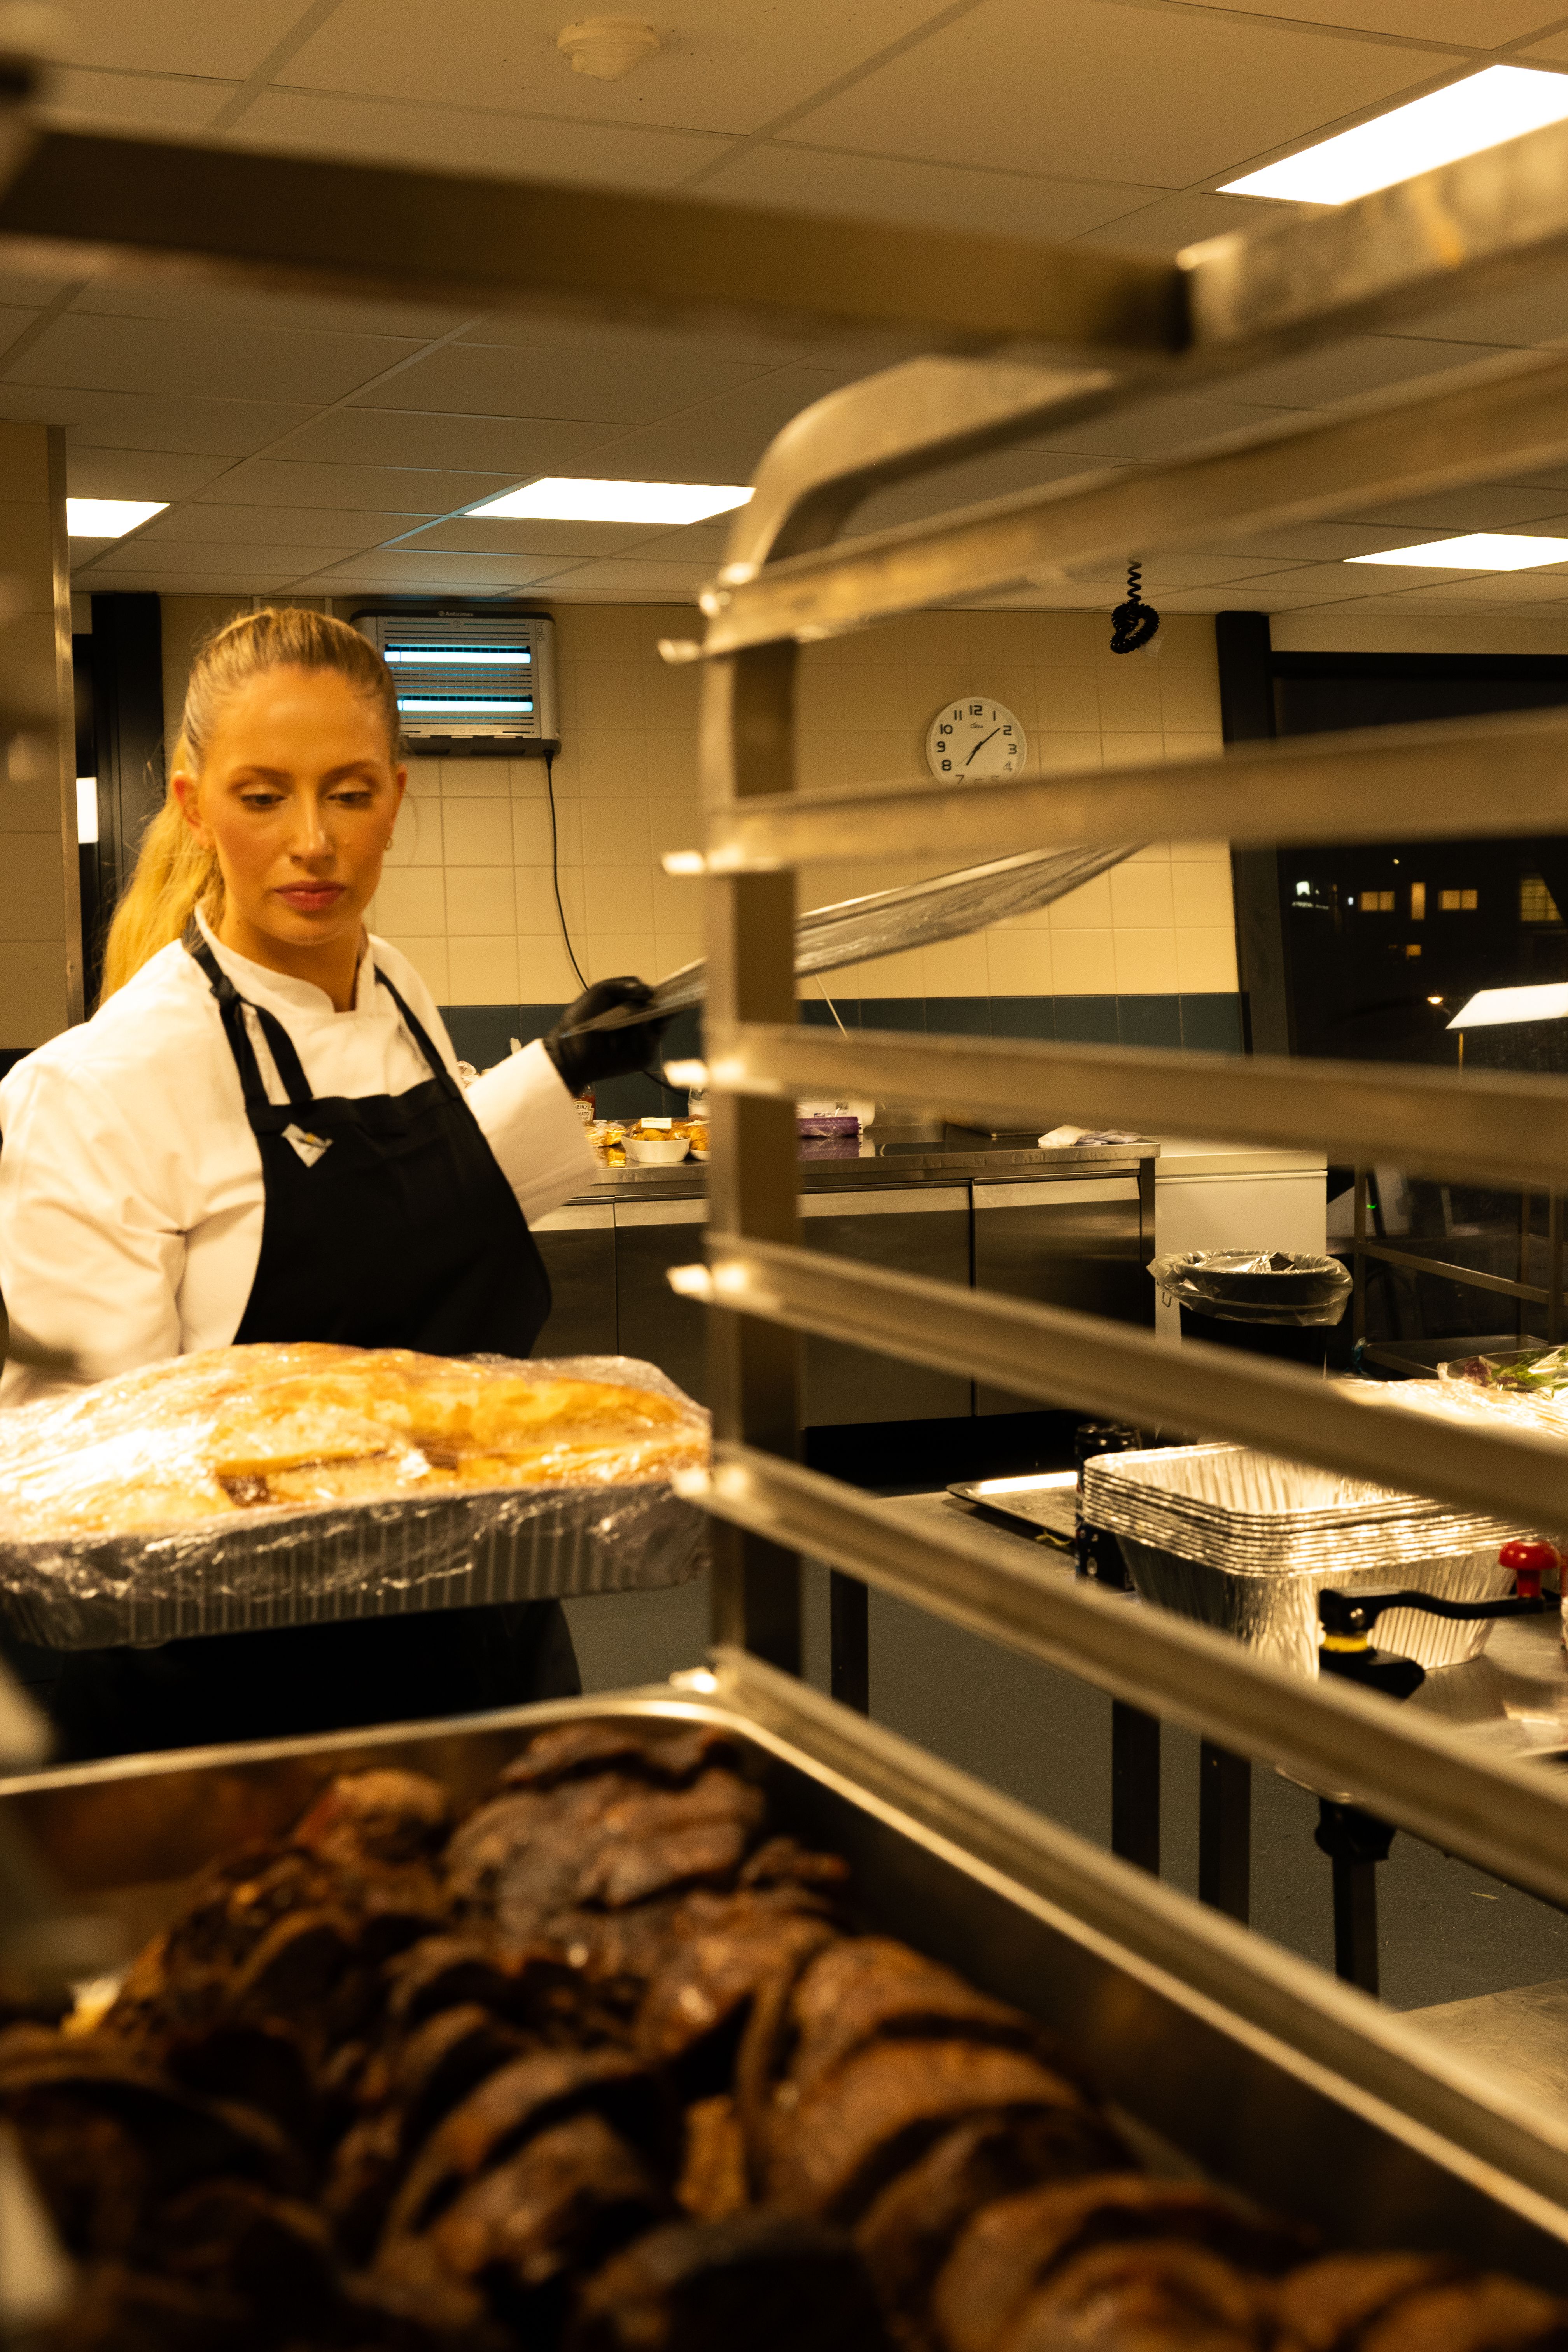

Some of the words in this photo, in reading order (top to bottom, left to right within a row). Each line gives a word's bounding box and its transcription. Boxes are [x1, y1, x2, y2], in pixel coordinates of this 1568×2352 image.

[954, 710, 962, 720] 11
[970, 705, 983, 716] 12
[993, 710, 996, 721] 1
[940, 724, 953, 734] 10
[1003, 725, 1012, 735] 2
[936, 741, 946, 752] 9
[1008, 744, 1017, 754] 3
[942, 760, 952, 771] 8
[1003, 761, 1012, 772] 4
[956, 774, 964, 784] 7
